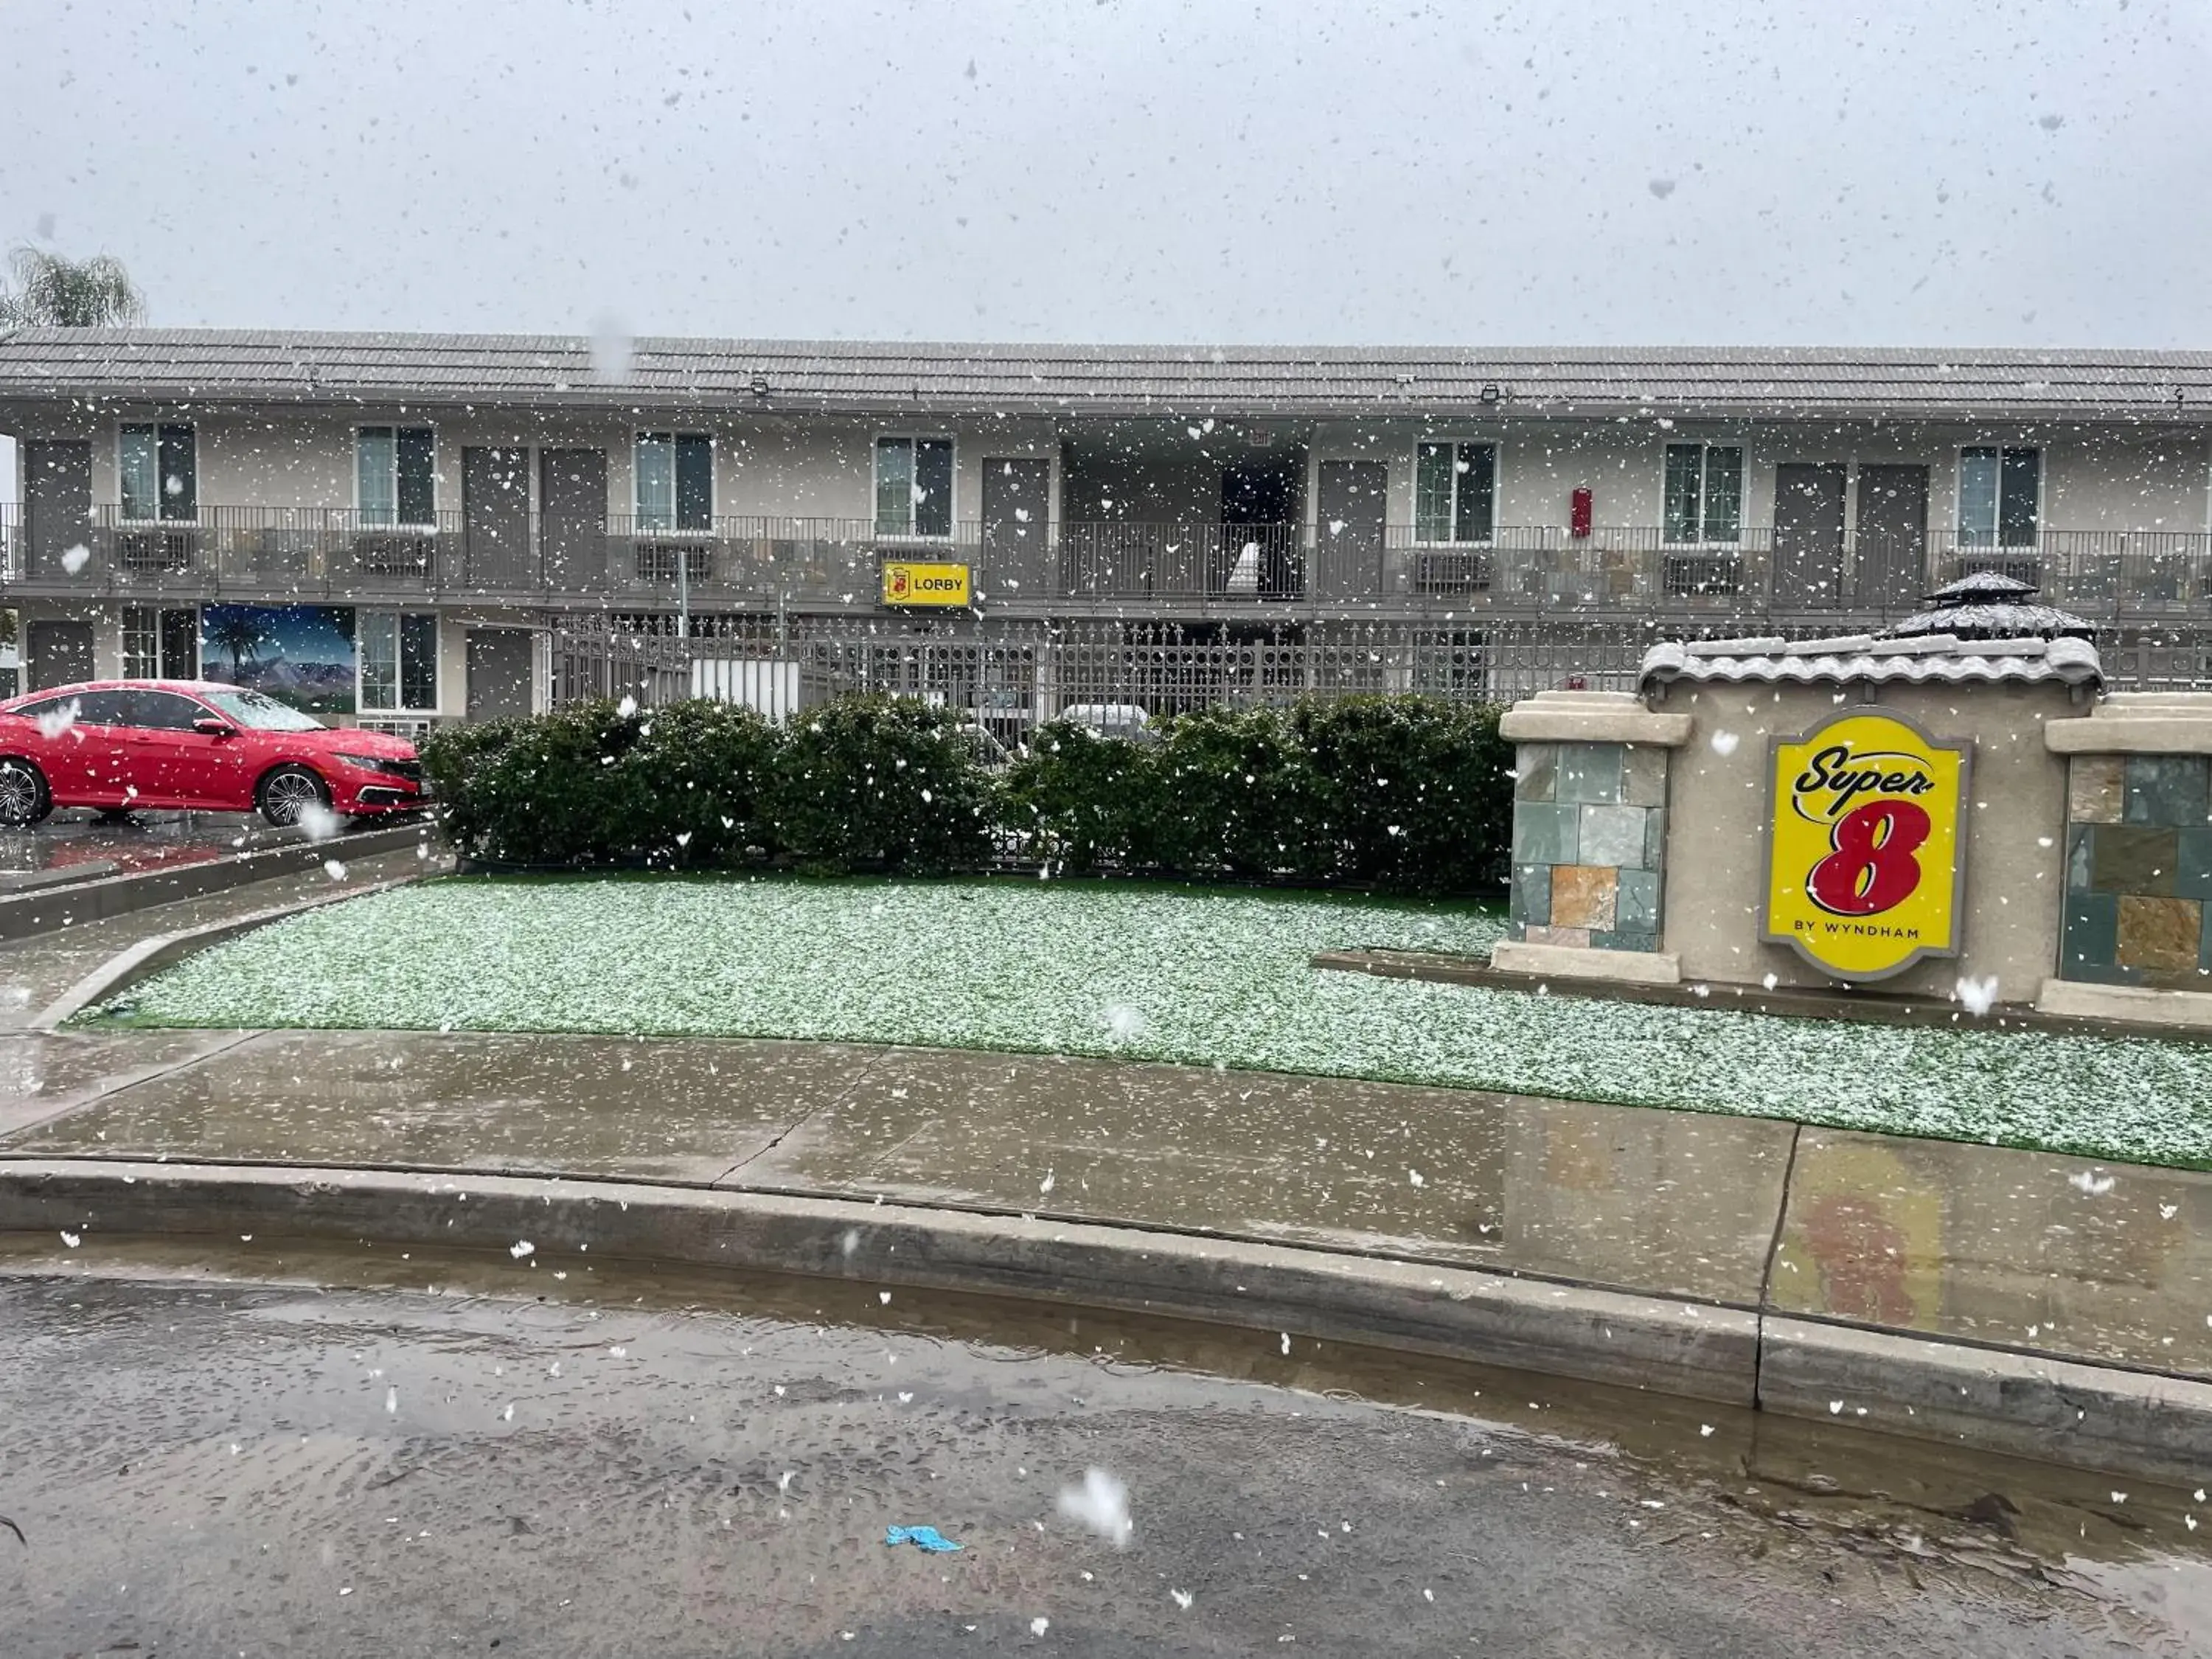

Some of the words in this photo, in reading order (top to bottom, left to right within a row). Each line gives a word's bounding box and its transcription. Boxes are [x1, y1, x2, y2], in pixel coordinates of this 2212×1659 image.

[915, 579, 962, 591] LOBBY
[1794, 745, 1935, 816] Super
[1806, 799, 1931, 917] 8
[1794, 920, 1815, 931] BY
[1825, 922, 1919, 939] WYNDHAM
